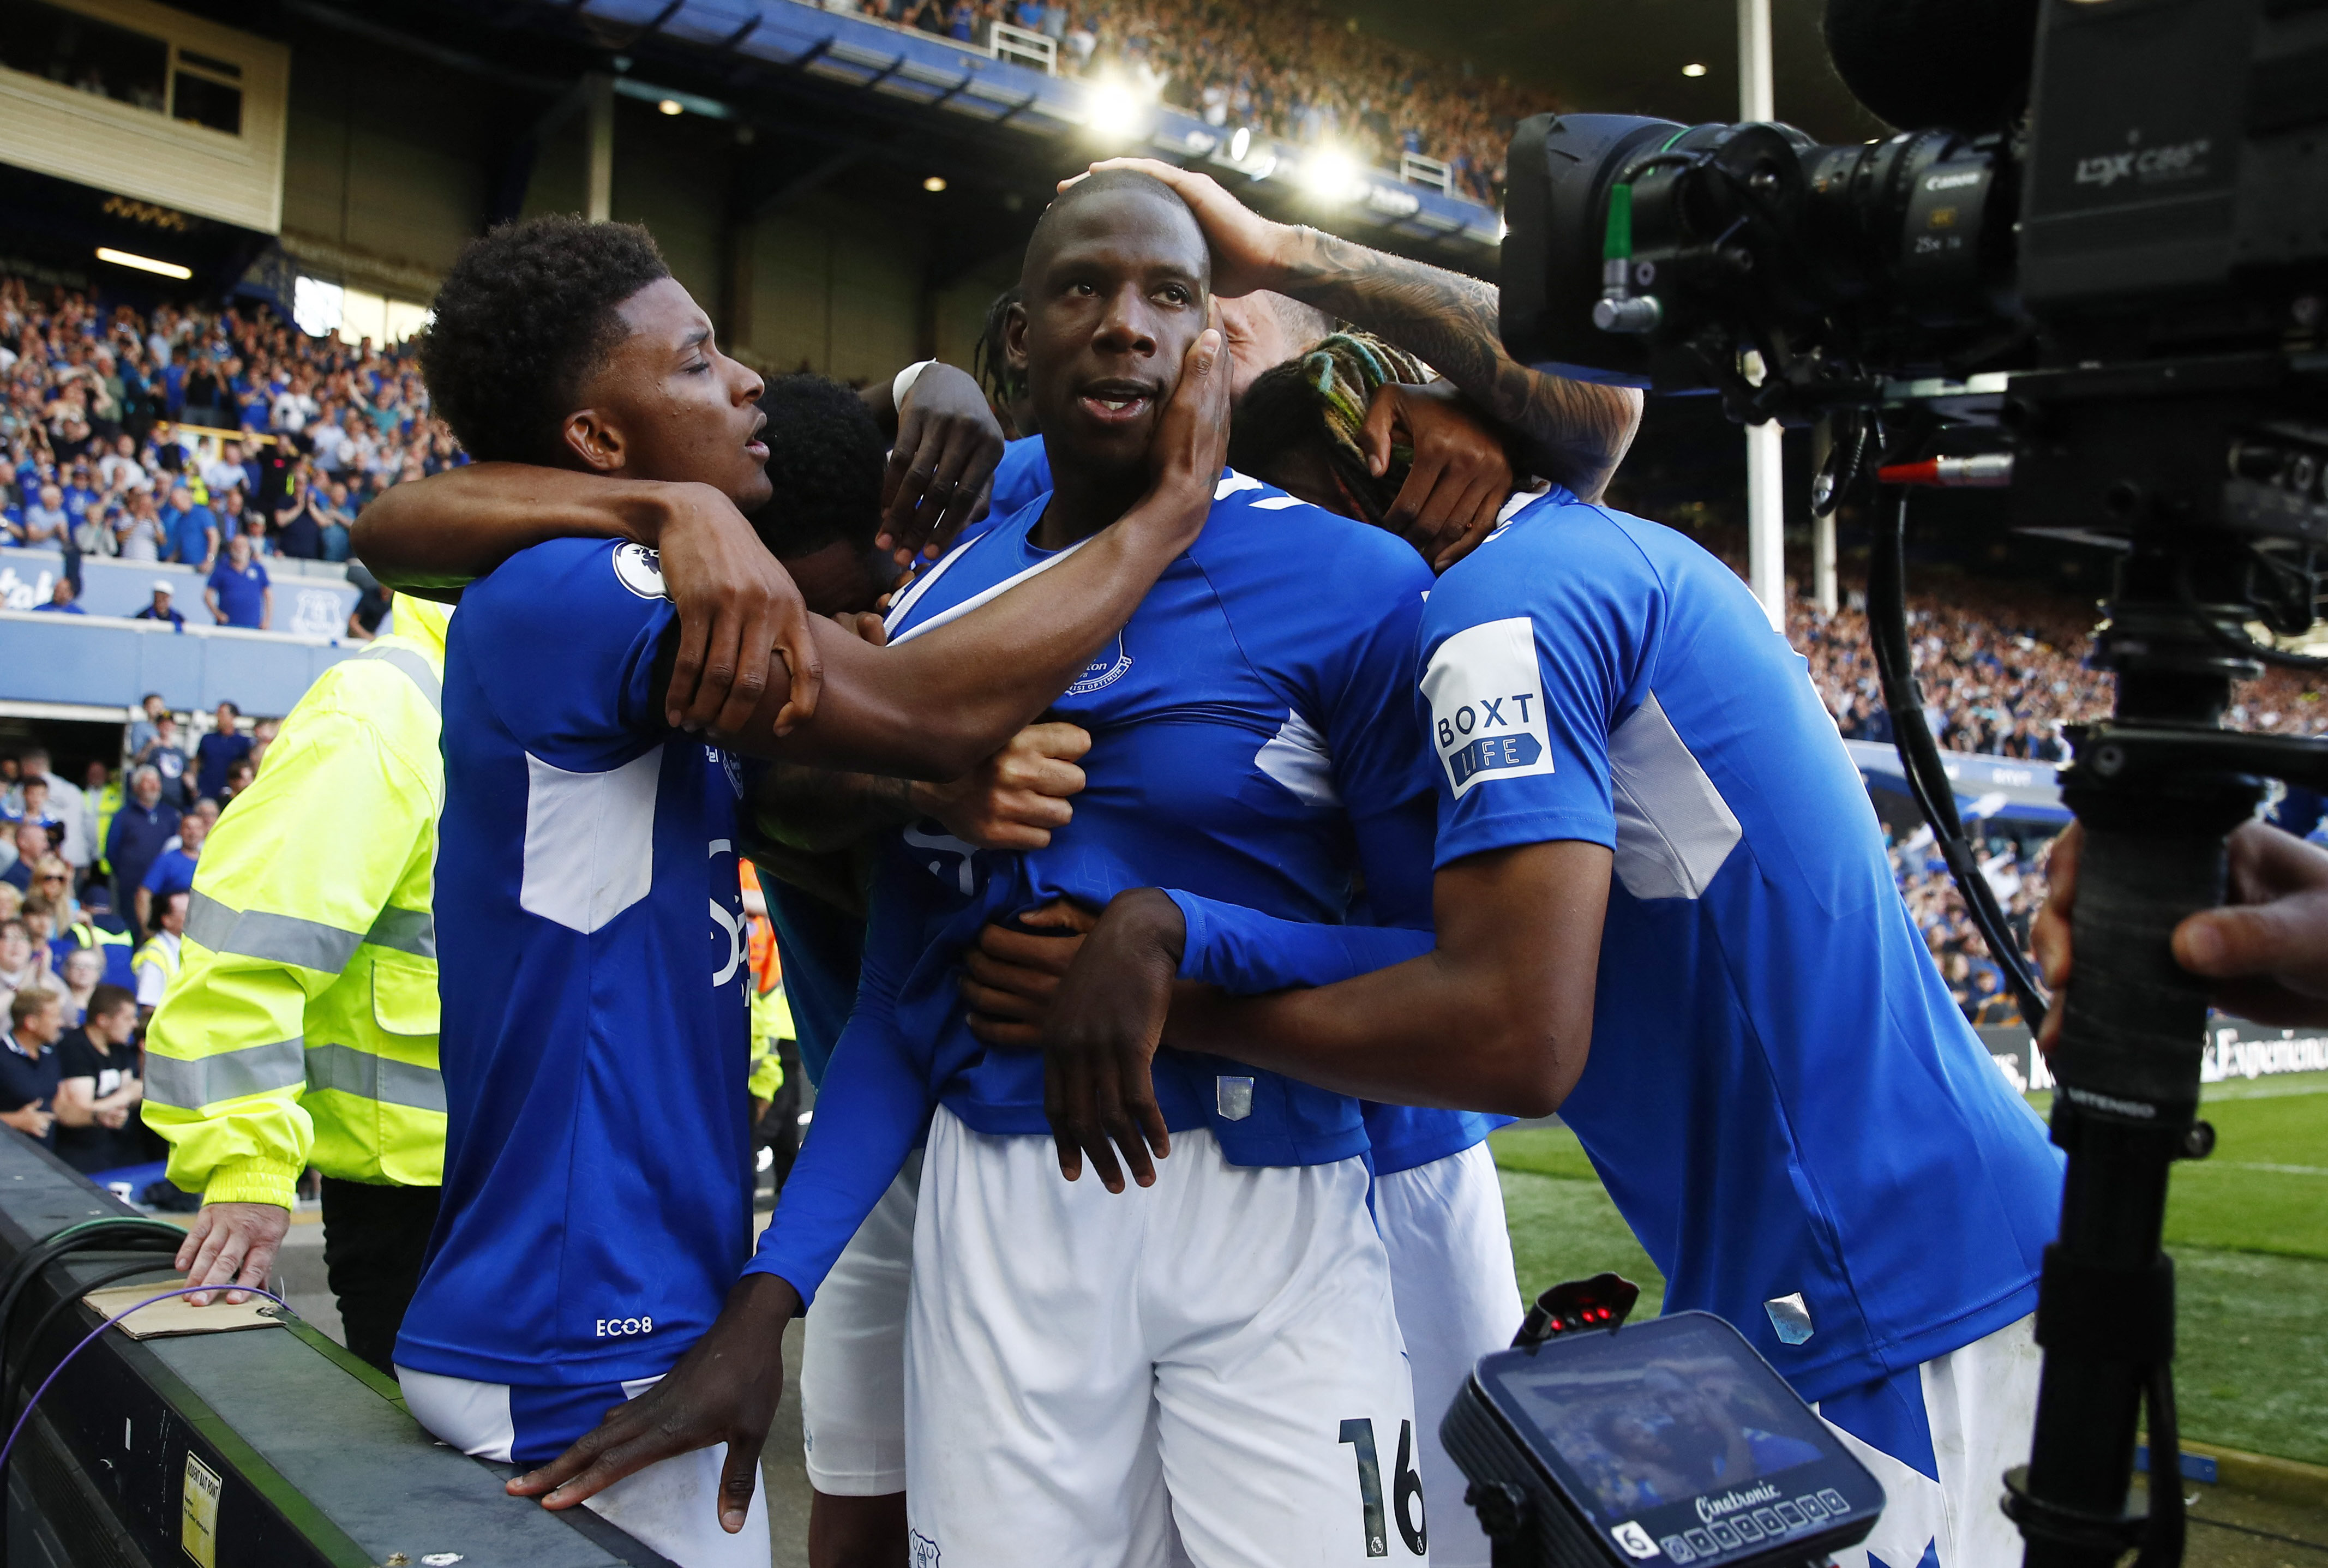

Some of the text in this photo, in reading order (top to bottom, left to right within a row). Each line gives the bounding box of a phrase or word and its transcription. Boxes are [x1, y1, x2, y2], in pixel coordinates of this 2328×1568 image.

[1087, 669, 1123, 690] OPTIMUM
[1438, 693, 1534, 748] BOXT
[1461, 738, 1520, 777] LIFE
[1339, 1418, 1427, 1558] 16
[1695, 1480, 1782, 1523] Cinetronic
[1623, 1528, 1647, 1552] 6
